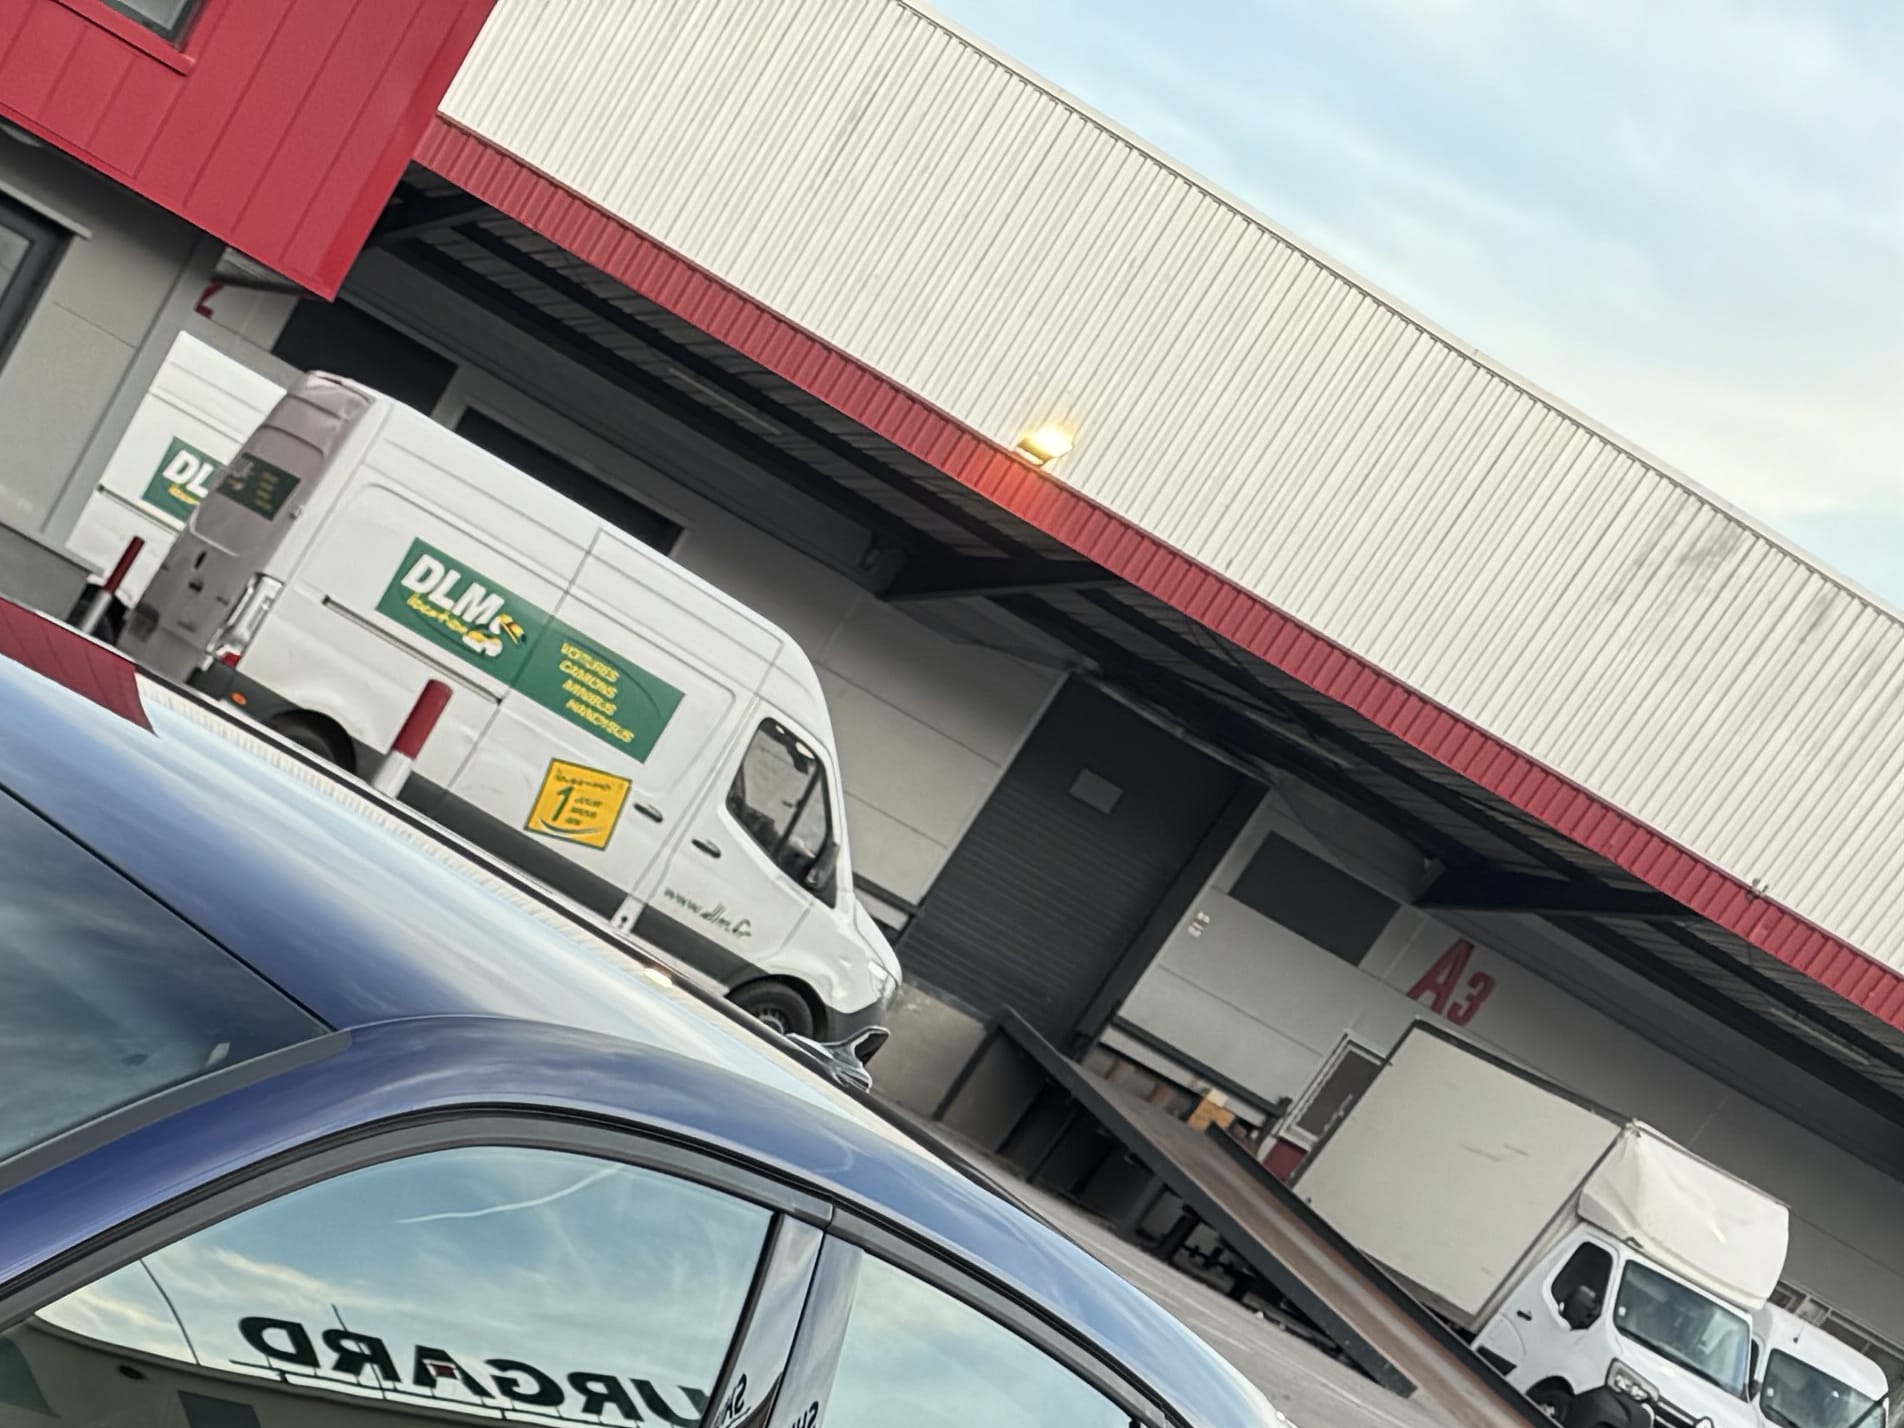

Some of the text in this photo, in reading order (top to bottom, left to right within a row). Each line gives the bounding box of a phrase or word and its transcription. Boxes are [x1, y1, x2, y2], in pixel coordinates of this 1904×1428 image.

[162, 450, 214, 497] DL
[400, 553, 505, 625] DLM
[1406, 937, 1496, 1027] A3
